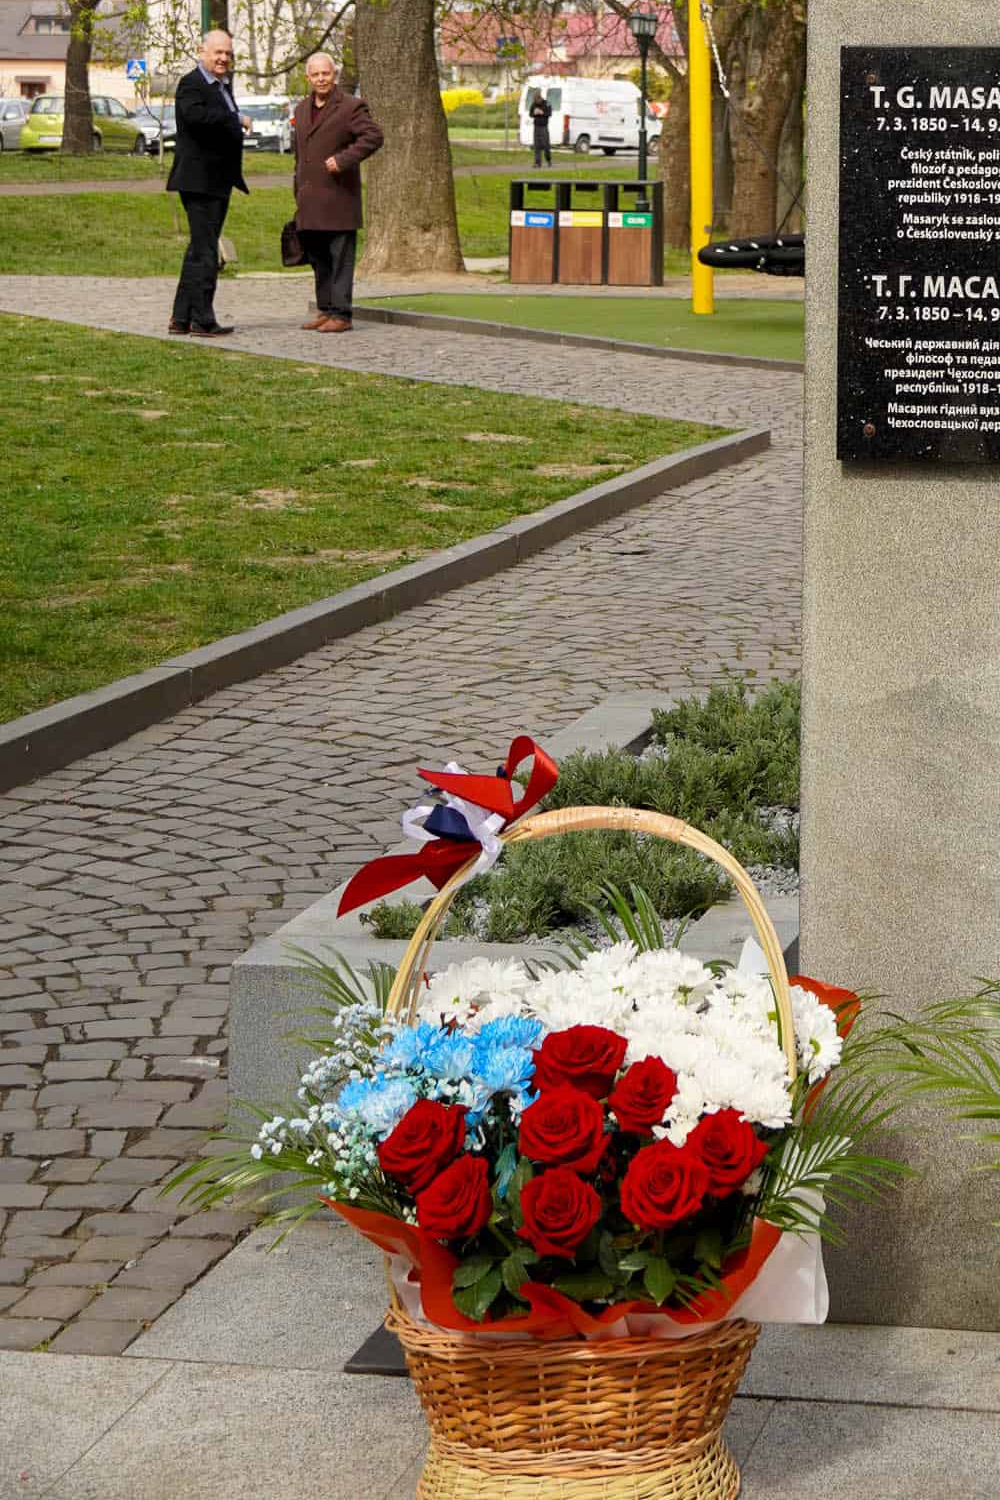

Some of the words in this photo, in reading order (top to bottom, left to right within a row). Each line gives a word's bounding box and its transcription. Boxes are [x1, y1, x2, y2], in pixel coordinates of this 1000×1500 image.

[911, 117, 948, 131] 1850
[900, 146, 933, 162] Český
[935, 147, 976, 161] státník,
[911, 162, 946, 174] filozof
[948, 165, 954, 174] a
[888, 178, 941, 190] prezident
[898, 192, 951, 206] republiky
[902, 213, 950, 227] Masaryk
[951, 216, 964, 225] se
[897, 230, 904, 239] o
[906, 226, 993, 242] Československý
[913, 306, 950, 321] 1850
[864, 336, 912, 349] Чеський
[914, 338, 980, 351] державний
[905, 351, 954, 366] філософ
[954, 355, 968, 364] та
[884, 368, 945, 380] президент
[895, 382, 960, 395] республіки
[887, 402, 938, 416] Масарик
[939, 403, 977, 417] гідний
[887, 417, 979, 431] Чехословацької
